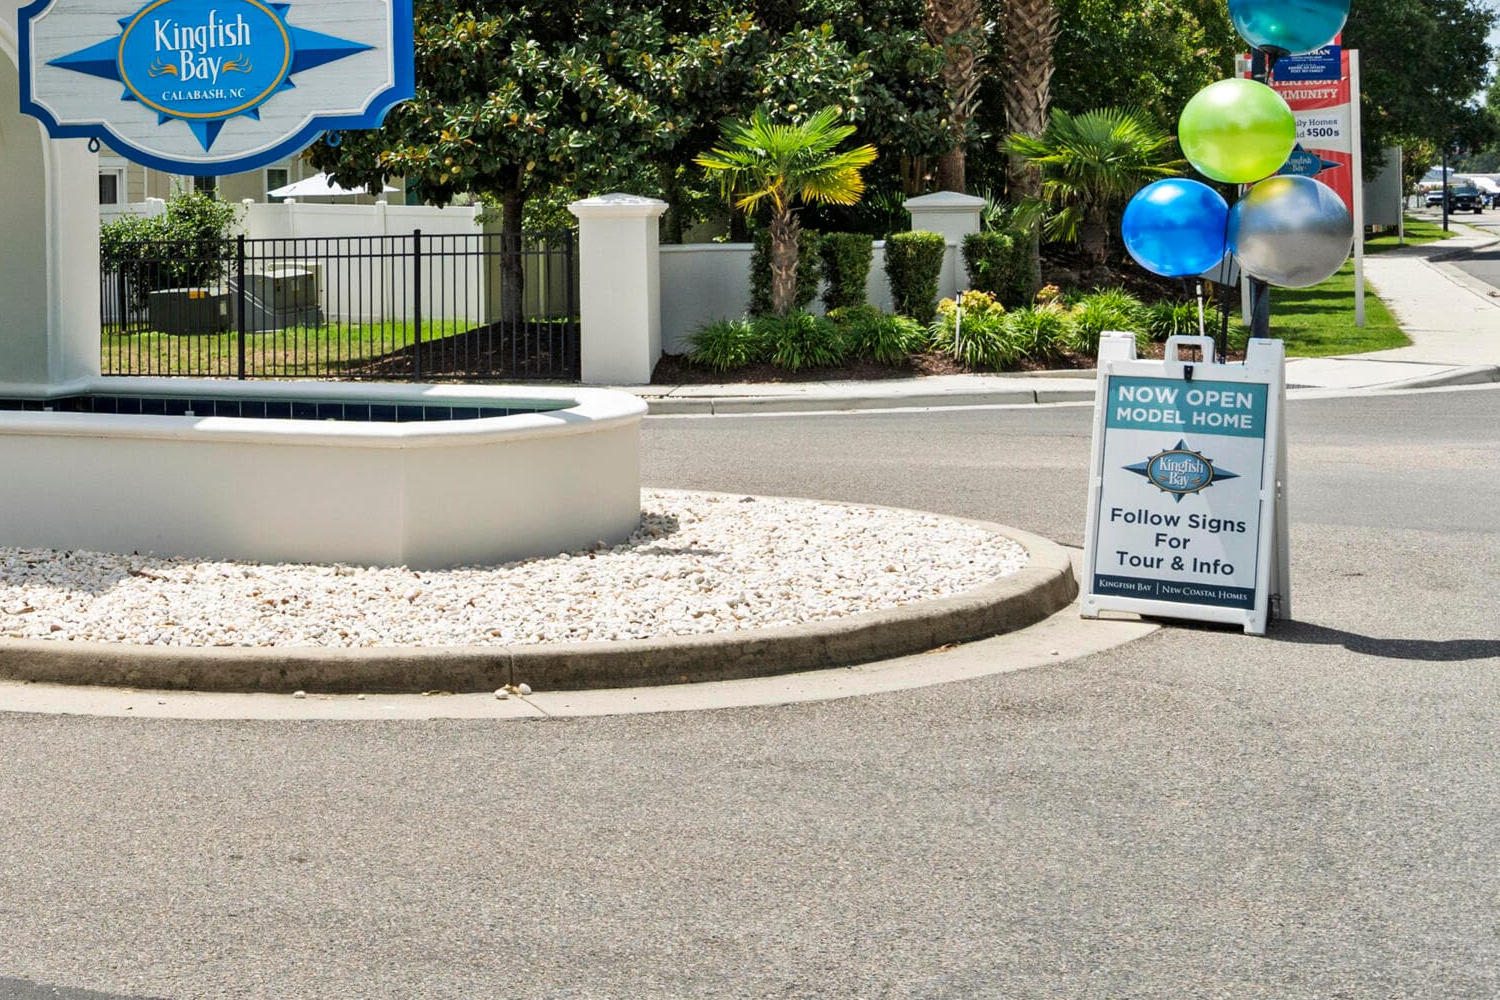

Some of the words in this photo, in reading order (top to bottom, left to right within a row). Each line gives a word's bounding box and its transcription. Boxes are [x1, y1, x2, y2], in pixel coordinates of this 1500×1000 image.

[153, 9, 251, 55] Kingfish
[179, 49, 223, 85] Bay
[161, 88, 227, 101] CALABASH,
[229, 87, 246, 98] NC
[1306, 127, 1340, 137] $500s
[1118, 385, 1179, 404] NOW
[1186, 389, 1253, 409] OPEN
[1116, 407, 1186, 424] MODEL
[1192, 411, 1253, 429] HOME
[1159, 456, 1204, 474] Kingfish
[1169, 471, 1190, 489] Bay
[1110, 507, 1181, 527] Follow
[1188, 513, 1247, 533] Signs
[1154, 532, 1191, 550] For
[1116, 550, 1164, 569] Tour
[1170, 555, 1185, 571] &
[1192, 557, 1235, 576] Info
